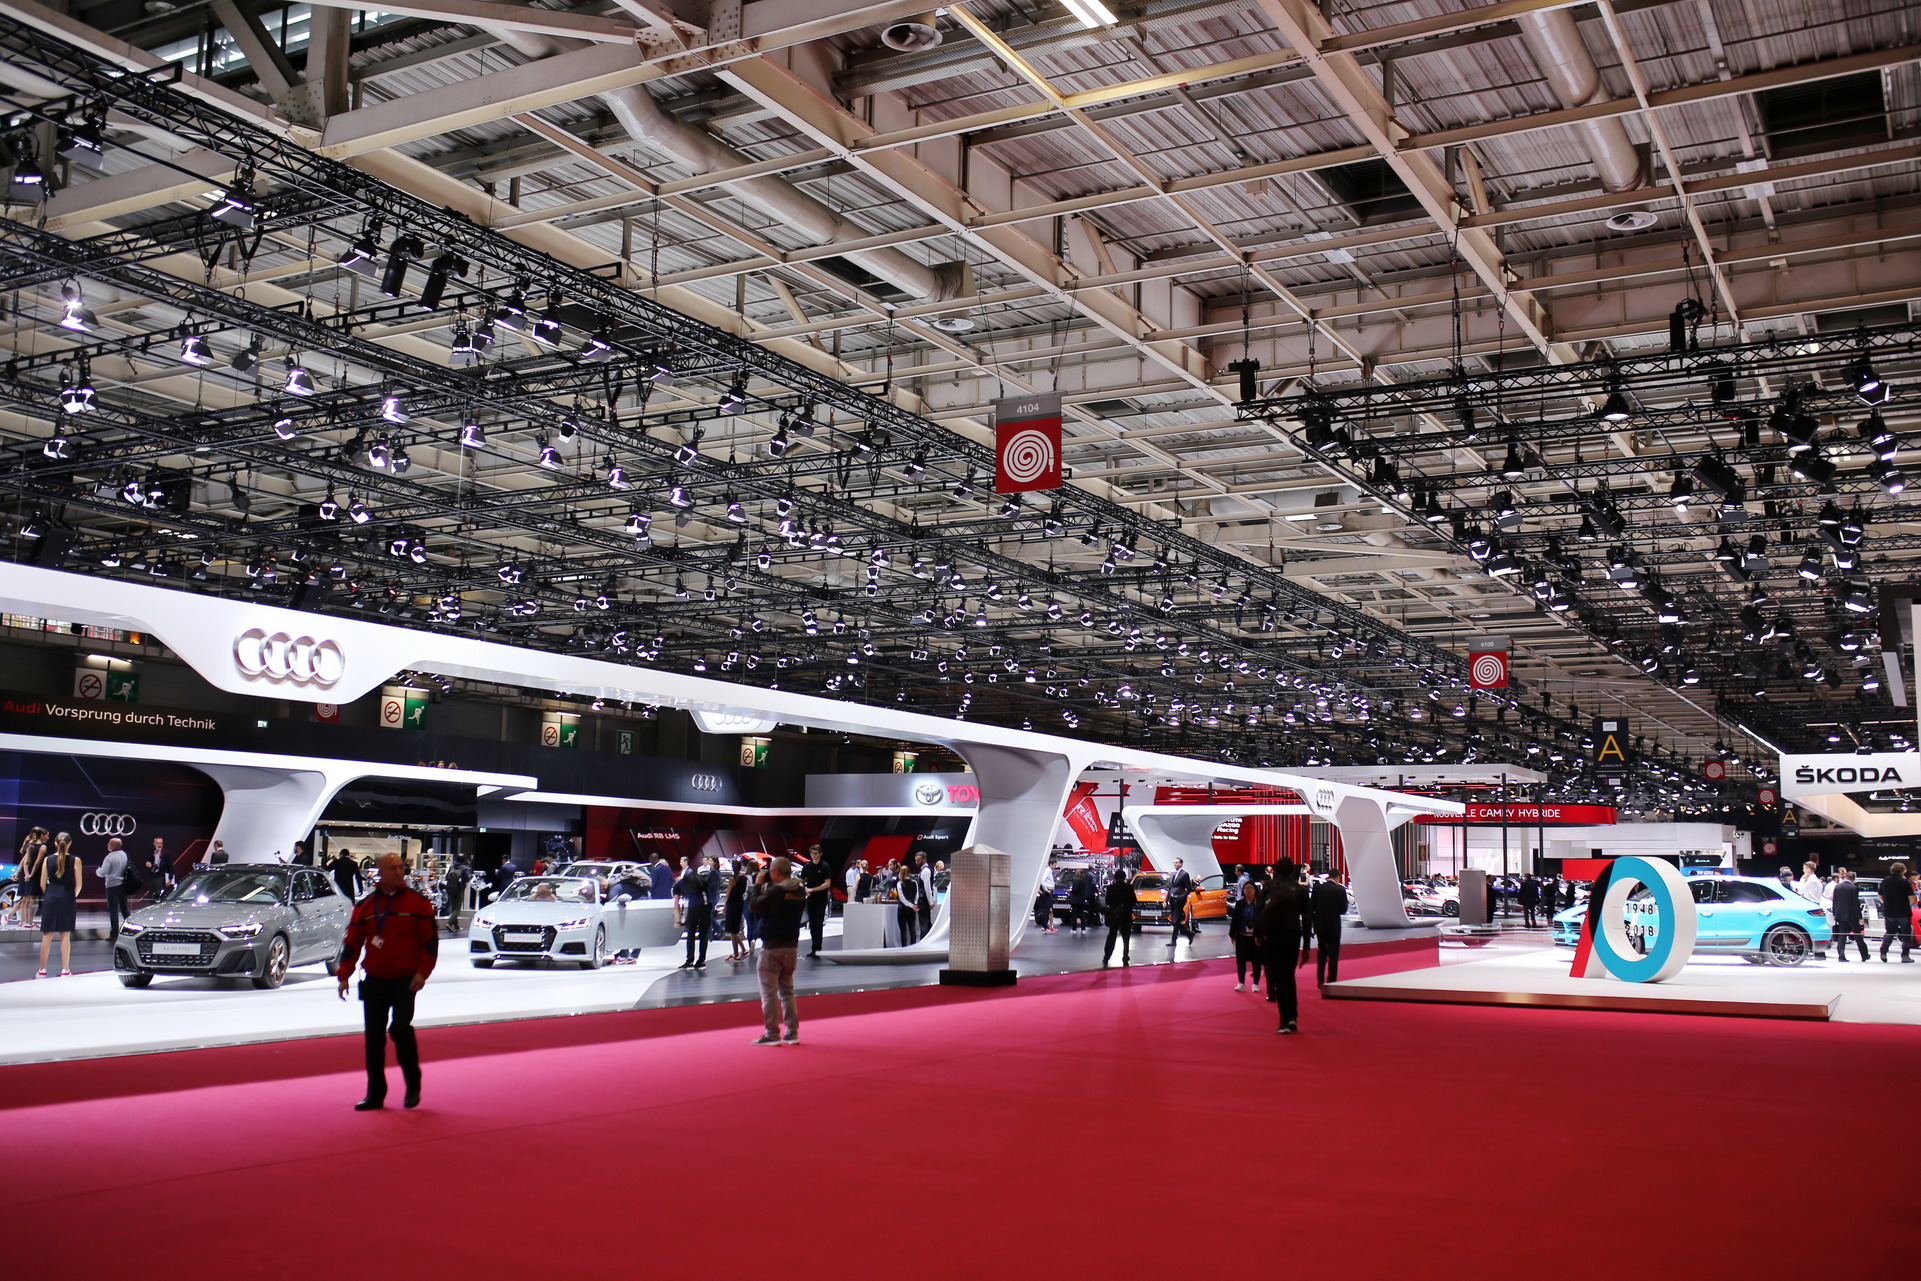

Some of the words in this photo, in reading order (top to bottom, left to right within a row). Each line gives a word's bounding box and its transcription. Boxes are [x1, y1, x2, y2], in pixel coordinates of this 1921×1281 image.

[1016, 403, 1040, 414] 4104
[3, 700, 41, 714] Audi
[46, 704, 121, 724] Vorsprung
[125, 712, 164, 726] durch
[167, 715, 216, 730] Technik
[1598, 734, 1625, 761] A
[1795, 765, 1903, 784] ŠKODA
[1518, 808, 1561, 818] HYBRIDE
[1782, 809, 1798, 824] A
[1625, 903, 1654, 915] 1948
[1624, 924, 1654, 937] 2018
